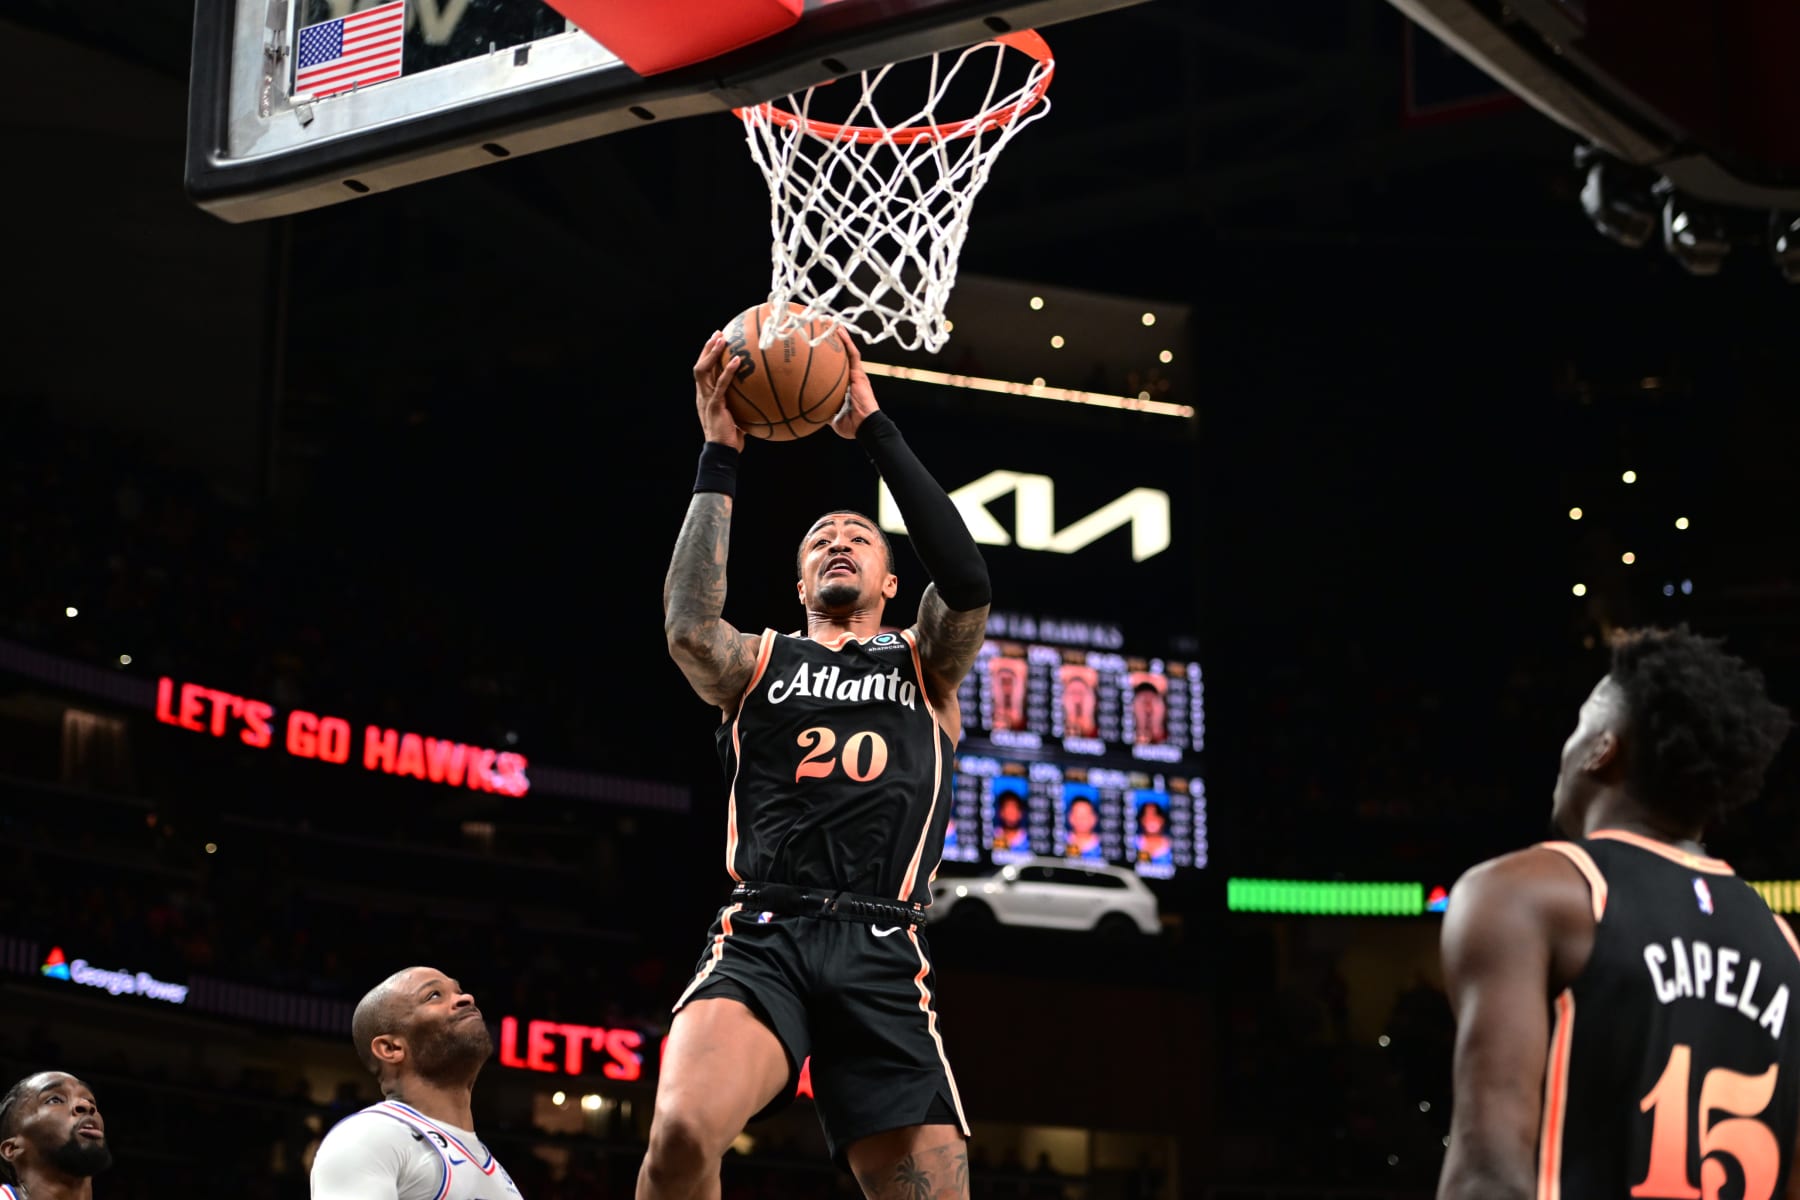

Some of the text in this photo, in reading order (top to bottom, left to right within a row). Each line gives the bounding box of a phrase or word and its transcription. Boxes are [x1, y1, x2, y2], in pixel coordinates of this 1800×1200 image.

[767, 662, 917, 711] Atlanta
[156, 677, 530, 797] LET'S GO HAWKS
[795, 726, 889, 784] 20
[70, 959, 189, 1004] Georgia Power
[1643, 936, 1791, 1040] CAPELA
[500, 1016, 643, 1082] LET'S
[1630, 1044, 1781, 1200] 15
